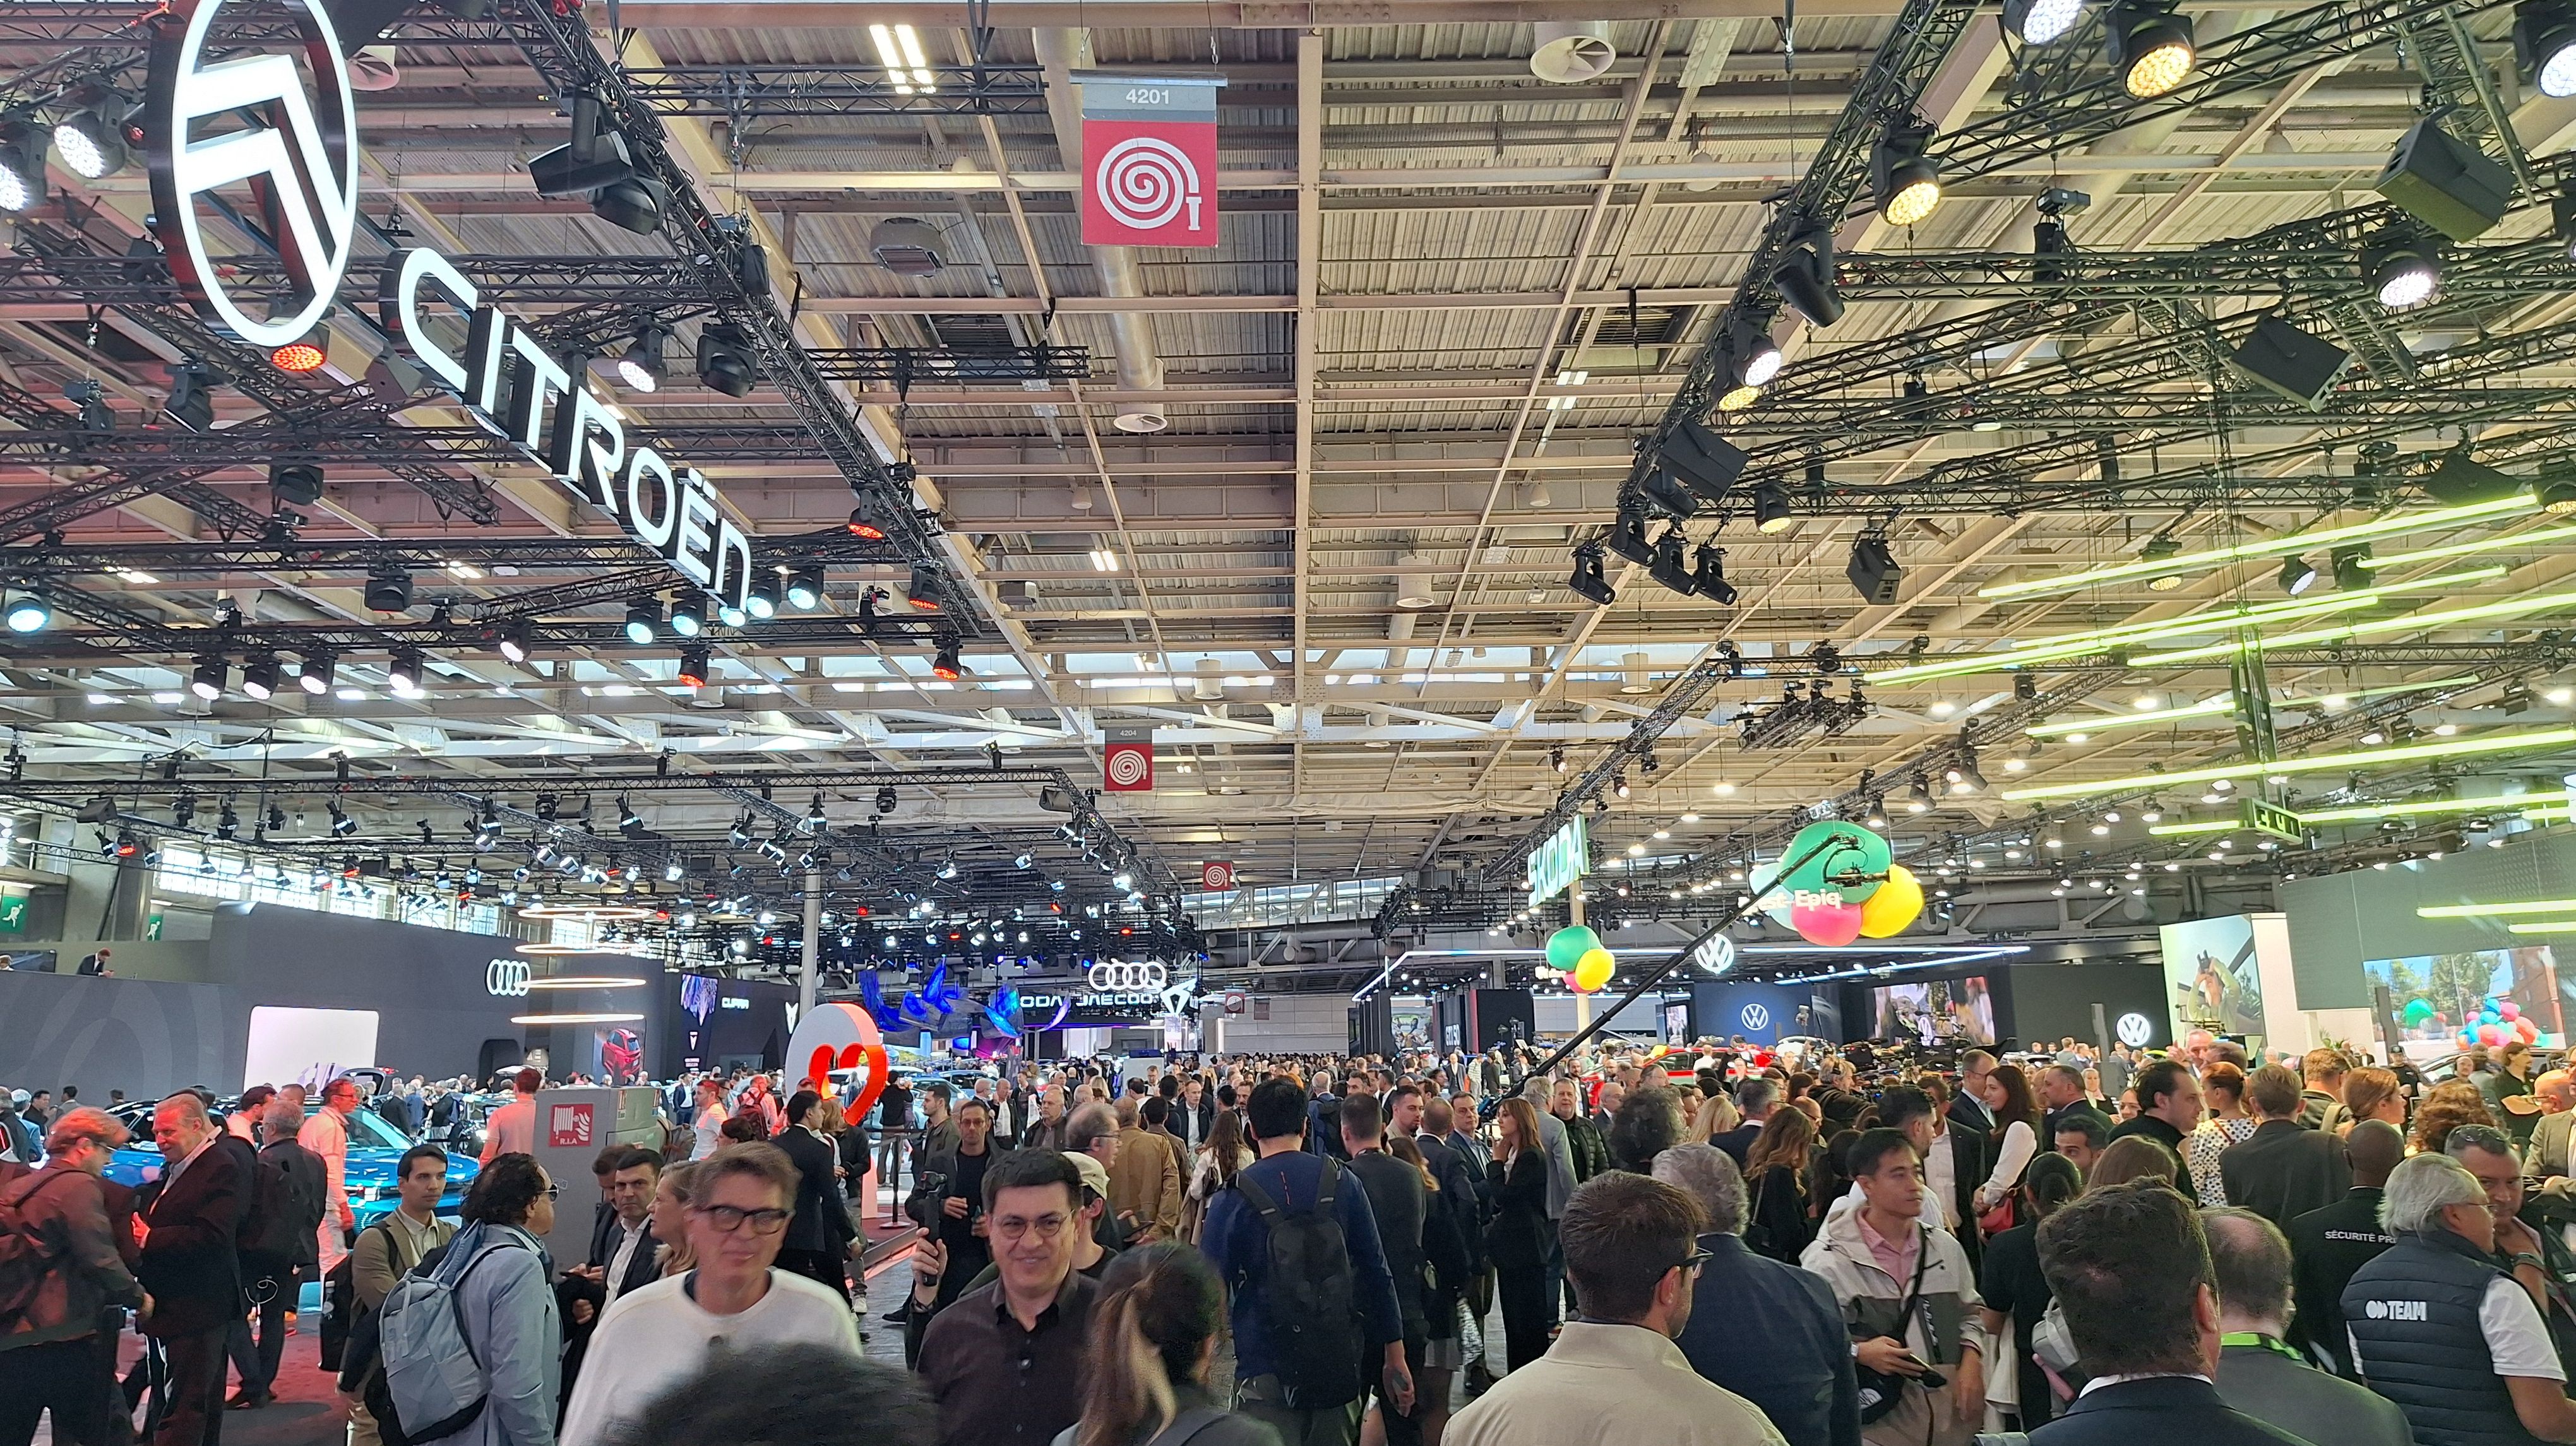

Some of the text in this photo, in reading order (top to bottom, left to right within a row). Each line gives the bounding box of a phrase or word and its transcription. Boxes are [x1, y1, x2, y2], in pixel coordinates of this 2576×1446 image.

[1126, 88, 1169, 104] 4201
[1794, 888, 1842, 911] Epiq
[1076, 993, 1152, 1006] JAECOO
[2325, 1230, 2376, 1242] SÉCURITÉ
[2387, 1300, 2427, 1321] TEAM
